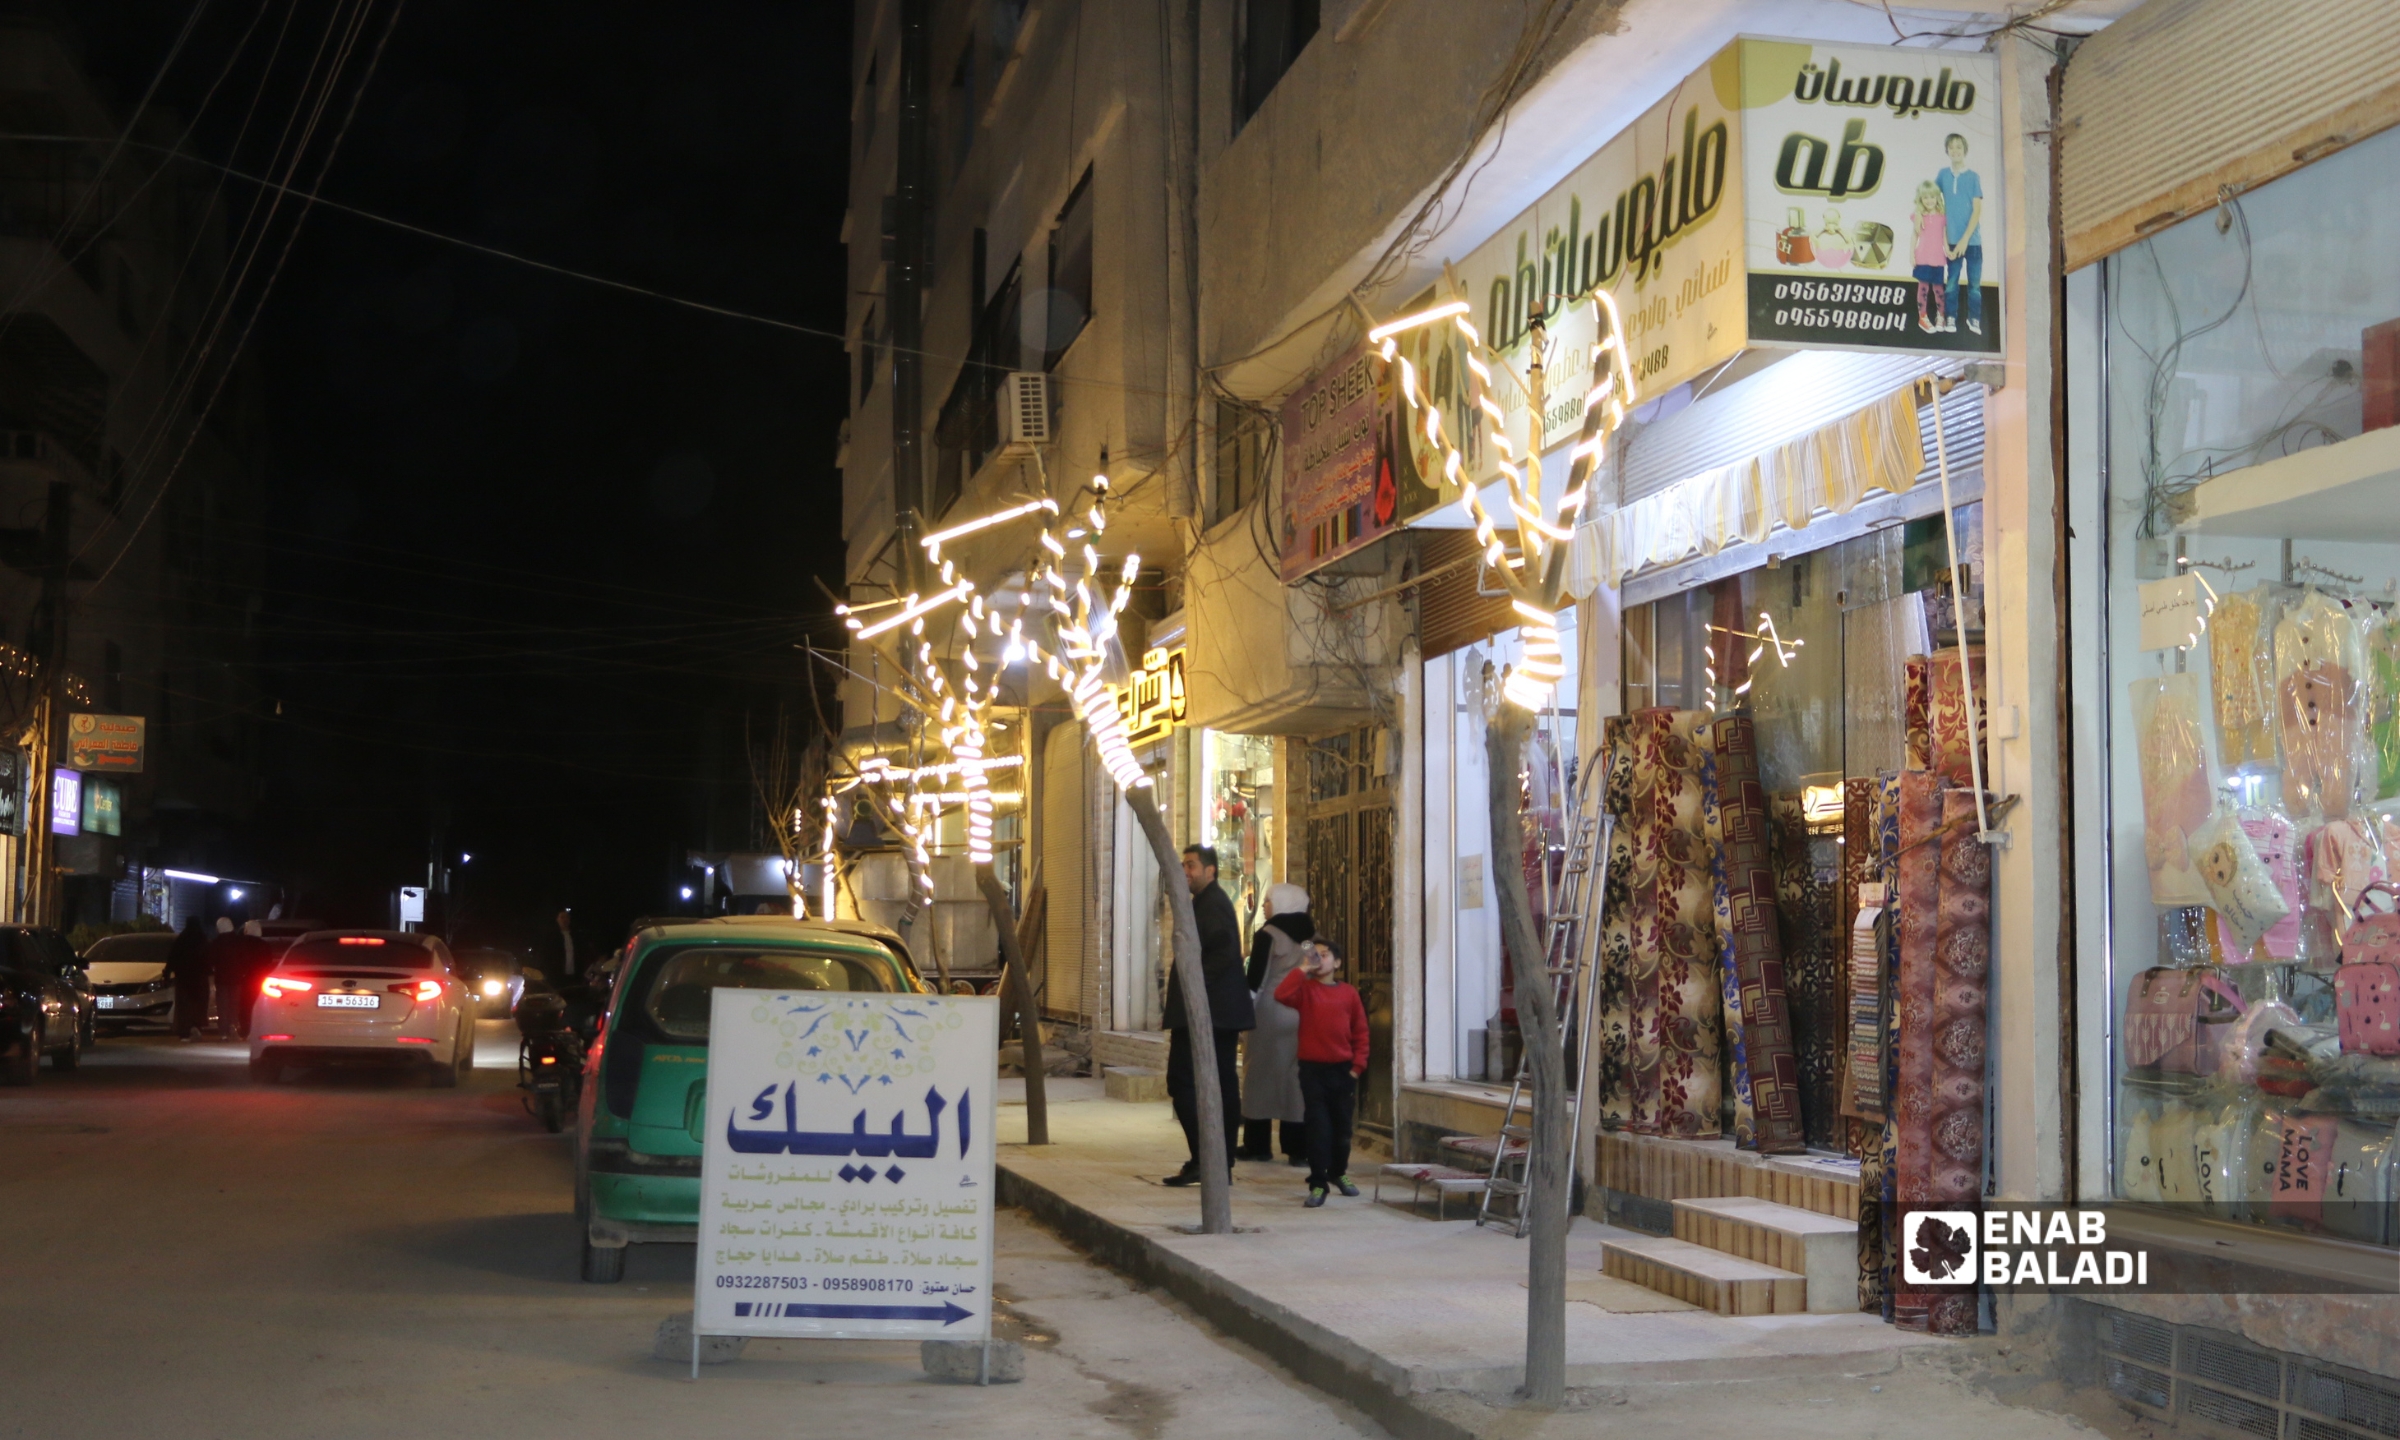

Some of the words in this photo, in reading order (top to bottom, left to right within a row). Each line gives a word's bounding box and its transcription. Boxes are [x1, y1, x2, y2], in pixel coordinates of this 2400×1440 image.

[1794, 56, 1976, 119] ملبوسات
[1773, 118, 1886, 203] طه
[1540, 104, 1729, 318] ملبوسات
[1487, 230, 1537, 357] طه
[1774, 281, 1907, 306] 0956313488
[1774, 308, 1908, 332] 0955988014
[1301, 387, 1327, 434] TOP
[1330, 354, 1375, 418] SHEEK
[53, 775, 78, 813] CUBE
[321, 995, 334, 1005] 15
[727, 1081, 972, 1186] البيك
[2280, 1129, 2295, 1192] MAMA
[2296, 1135, 2312, 1191] LOVE
[728, 1162, 833, 1185] للمفروشات
[2200, 1150, 2215, 1207] LOVE
[721, 1192, 772, 1213] عربية
[777, 1197, 826, 1214] مجالس
[838, 1198, 875, 1217] برادي
[880, 1197, 929, 1217] وتركيب
[932, 1198, 977, 1218] تفصيل
[719, 1221, 755, 1240] سجاد
[760, 1219, 813, 1240] كفرات
[939, 1224, 977, 1241] كافة
[715, 1248, 757, 1266] حجاج
[761, 1247, 802, 1267] هدايا
[814, 1248, 845, 1265] صلاة
[849, 1248, 889, 1267] طقم
[902, 1250, 932, 1266] صلاة
[937, 1251, 978, 1269] سجاد
[715, 1275, 808, 1290] 0932287503
[822, 1277, 914, 1293] 0958908170
[951, 1285, 977, 1296] حسان
